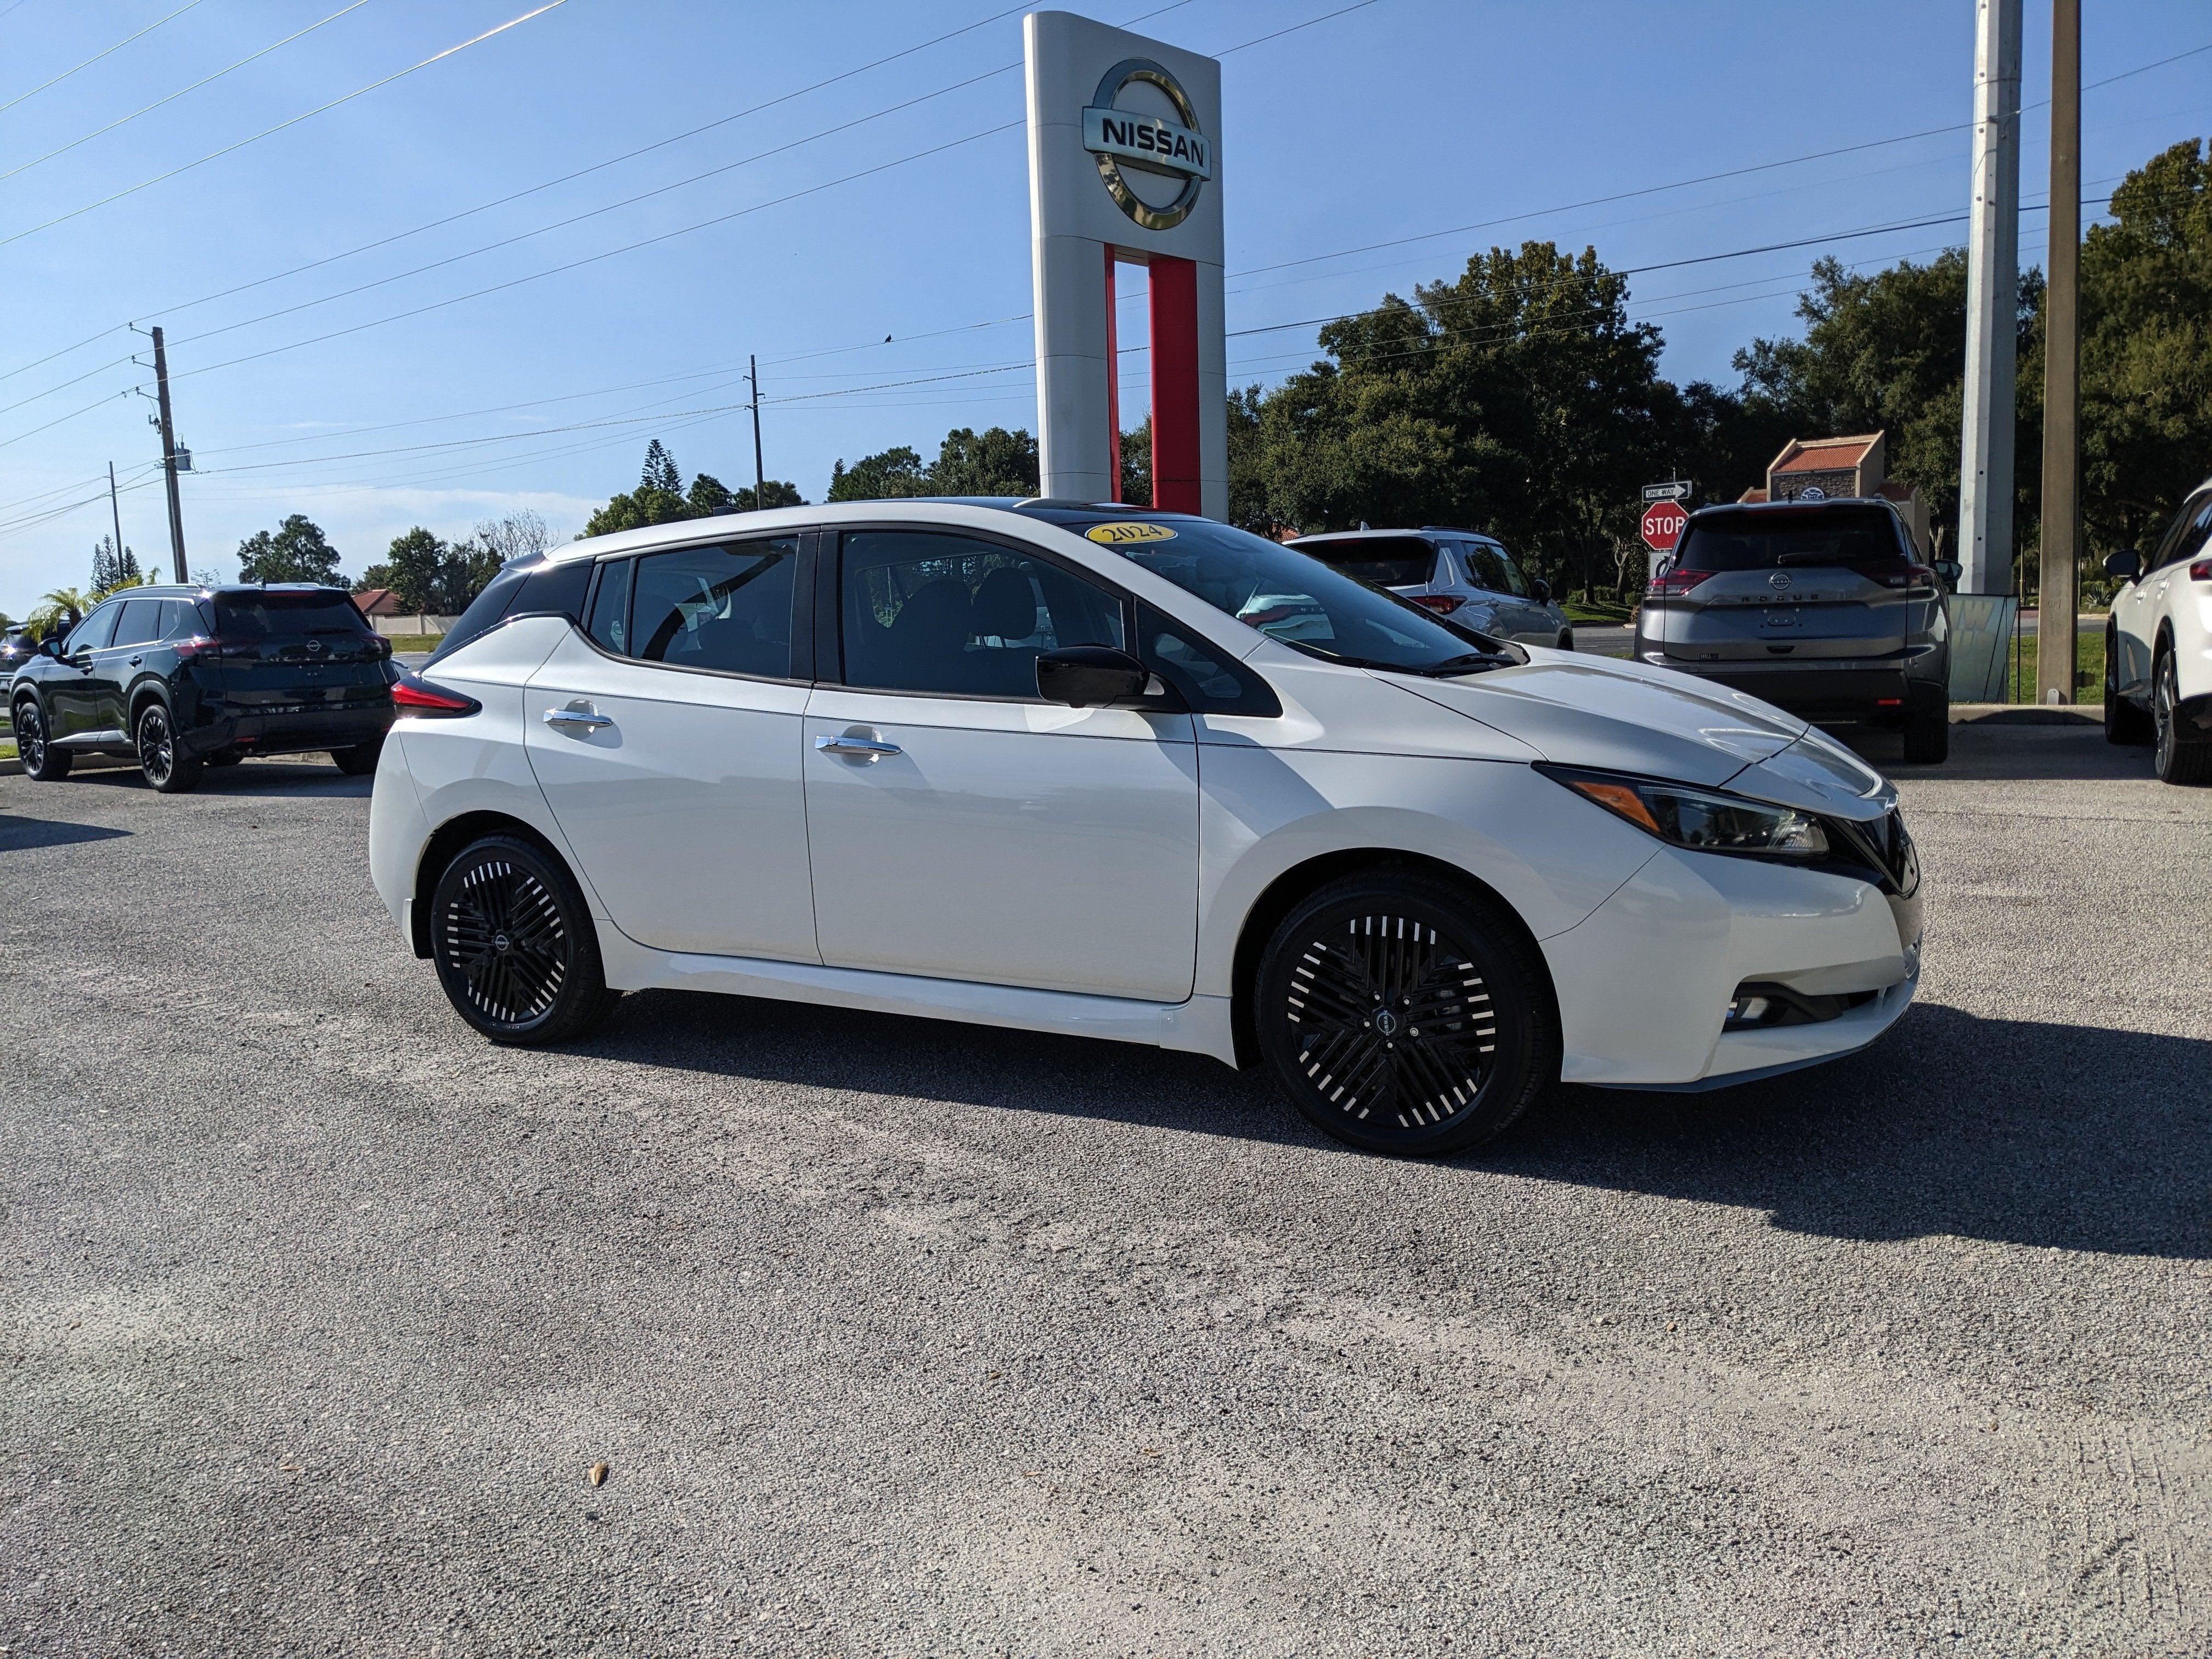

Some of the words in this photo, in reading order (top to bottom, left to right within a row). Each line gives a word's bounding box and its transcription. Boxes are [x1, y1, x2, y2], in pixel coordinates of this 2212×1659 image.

[1103, 118, 1204, 167] NISSAN
[1102, 524, 1164, 543] 2024
[1645, 516, 1686, 535] STOP
[1742, 594, 1819, 602] ROGUE
